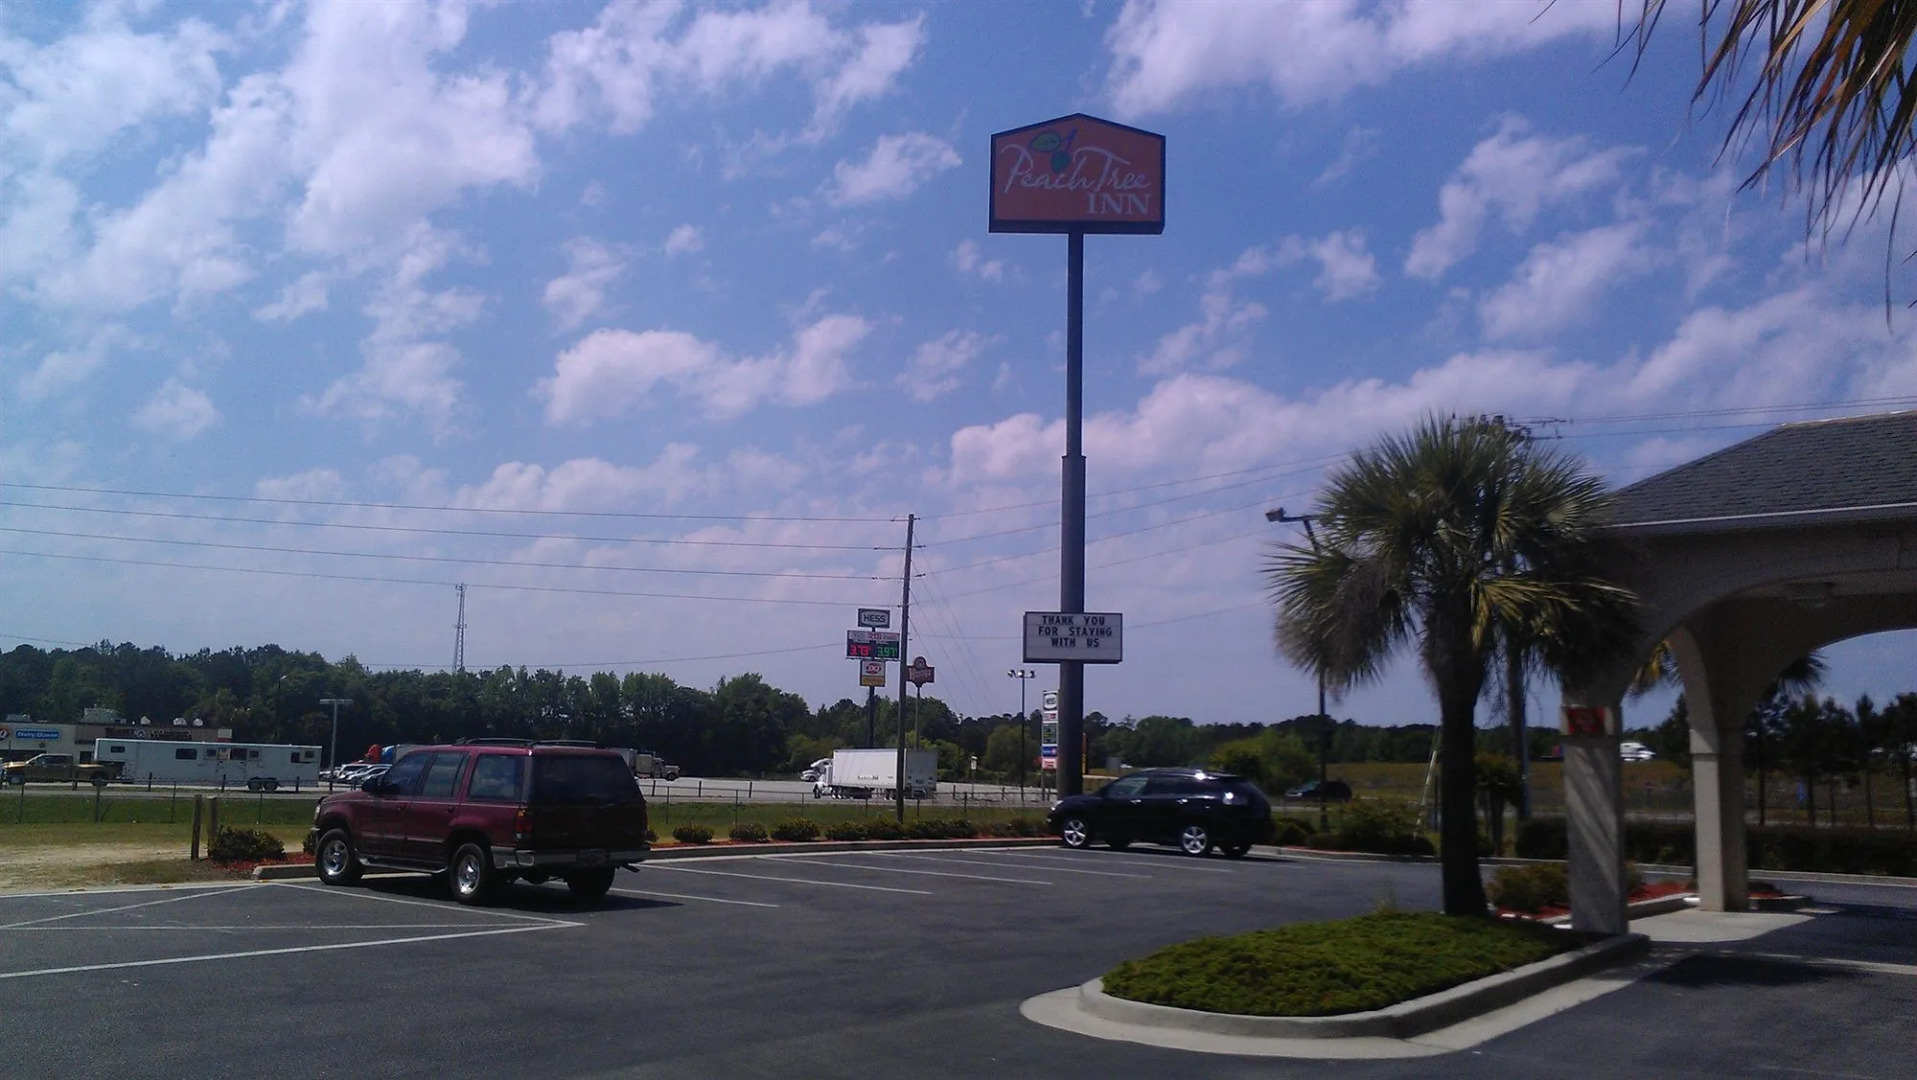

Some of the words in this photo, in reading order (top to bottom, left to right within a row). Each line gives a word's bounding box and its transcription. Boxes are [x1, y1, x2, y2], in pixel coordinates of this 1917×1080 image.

[1001, 144, 1096, 194] Peach
[1072, 146, 1152, 192] Tree
[1086, 193, 1153, 215] INN
[863, 614, 886, 623] HESS
[1041, 615, 1074, 625] THANK
[1083, 616, 1105, 626] YOU
[1038, 626, 1059, 636] FOR
[1069, 627, 1112, 637] STAYING
[1051, 637, 1076, 647] WITH
[1086, 638, 1100, 648] US
